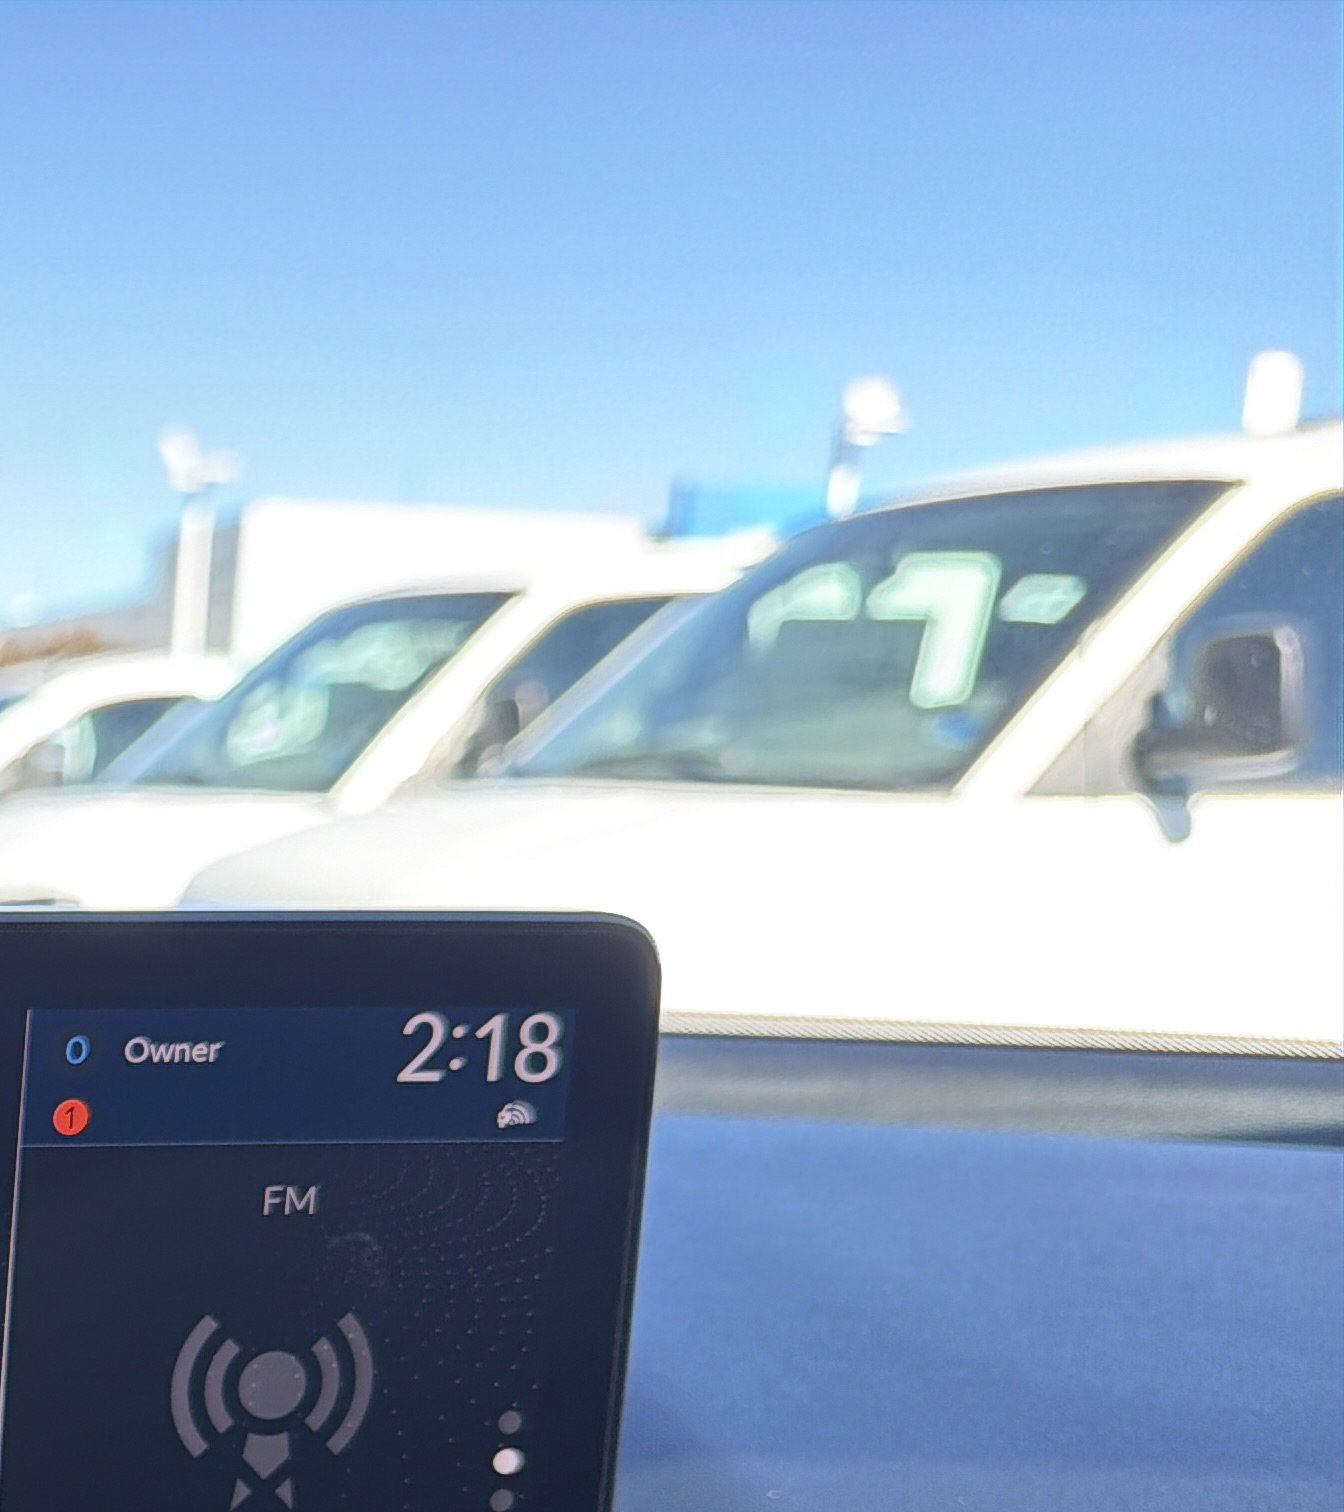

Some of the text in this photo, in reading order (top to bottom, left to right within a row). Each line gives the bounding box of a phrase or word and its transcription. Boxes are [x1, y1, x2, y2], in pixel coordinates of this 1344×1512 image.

[125, 1037, 223, 1063] Owner
[397, 1013, 560, 1082] 2:18
[264, 1185, 319, 1215] FM
